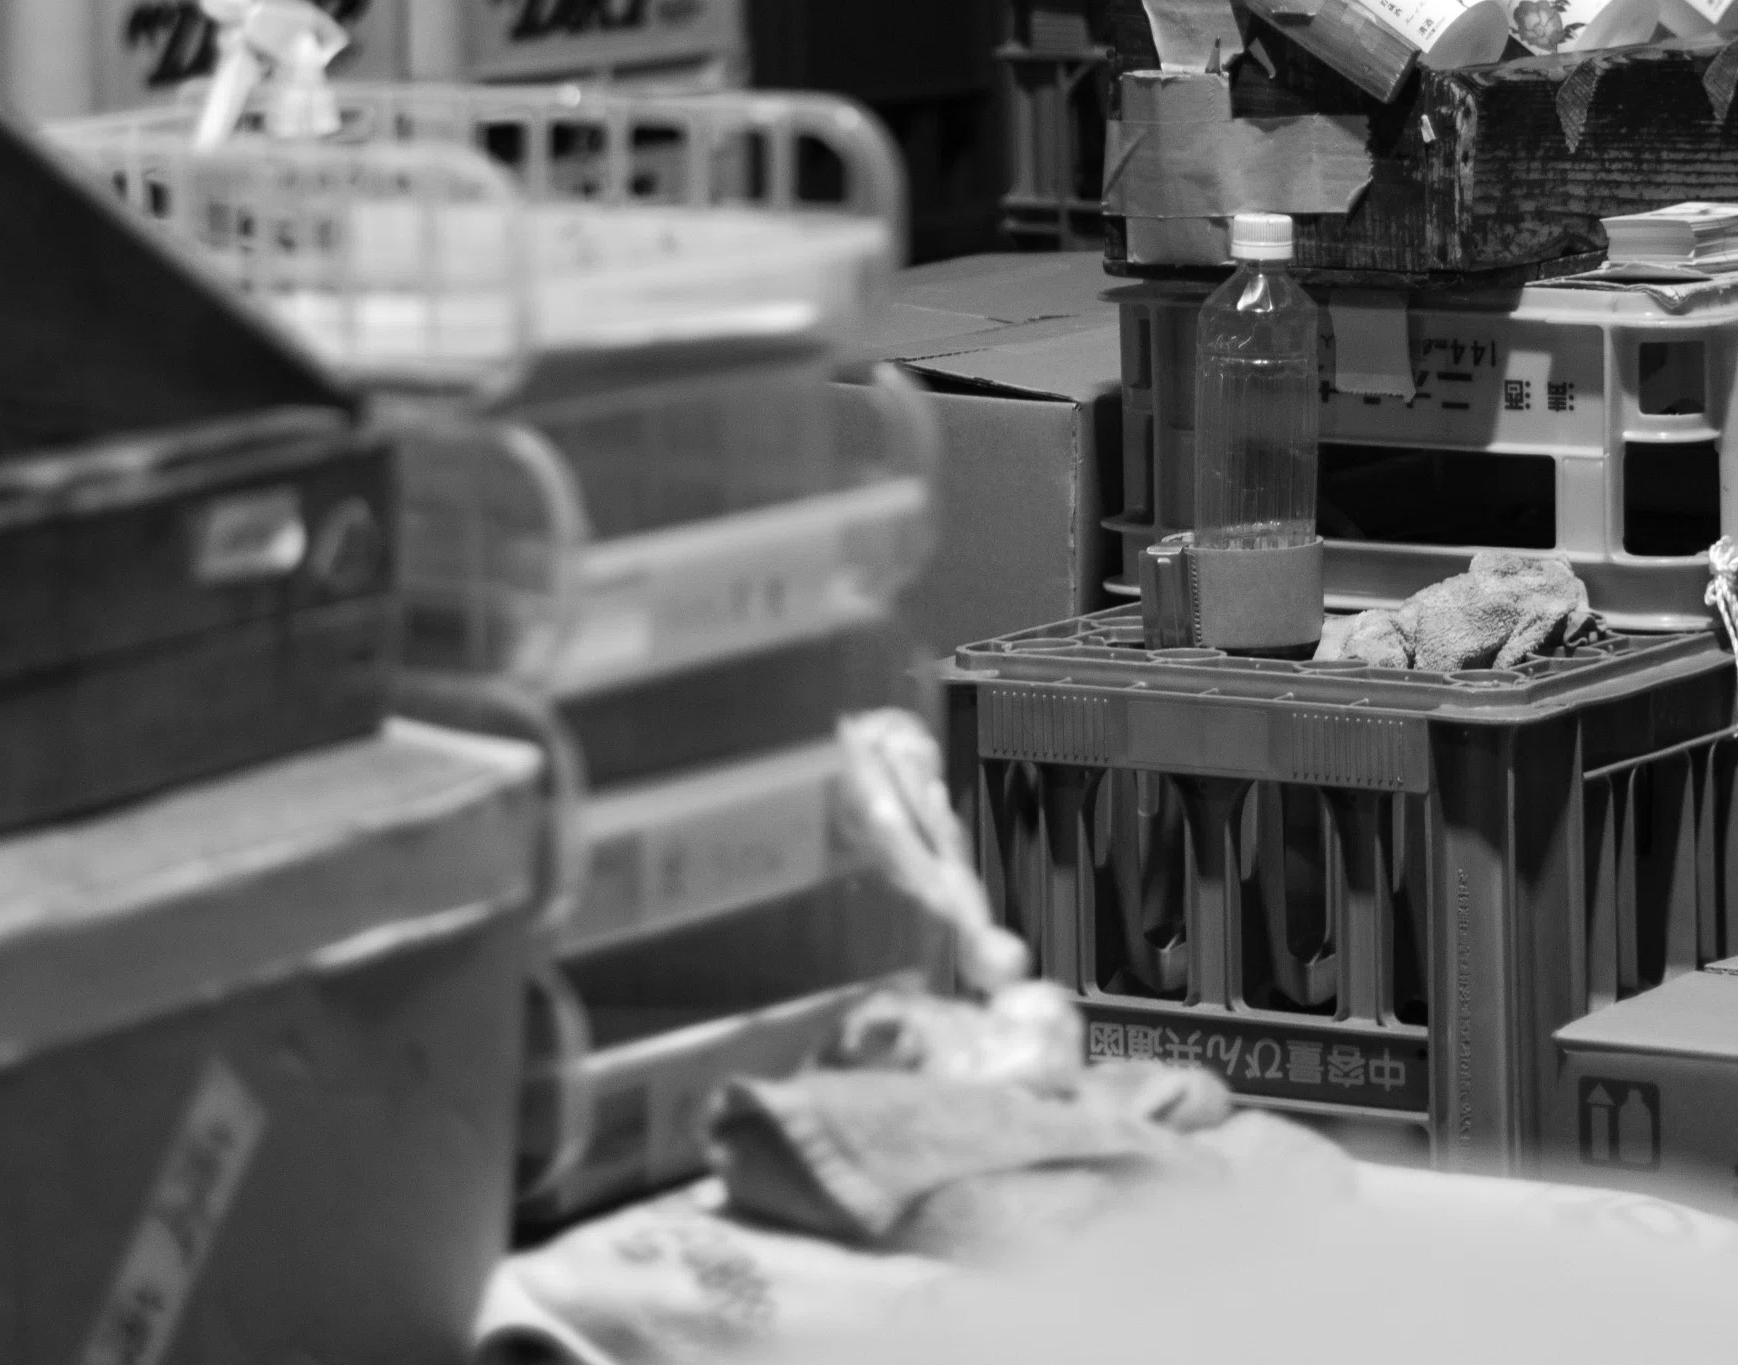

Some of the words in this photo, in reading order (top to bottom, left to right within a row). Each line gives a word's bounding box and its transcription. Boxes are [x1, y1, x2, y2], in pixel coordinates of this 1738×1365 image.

[1088, 1020, 1406, 1092] 中容量びん共通函
